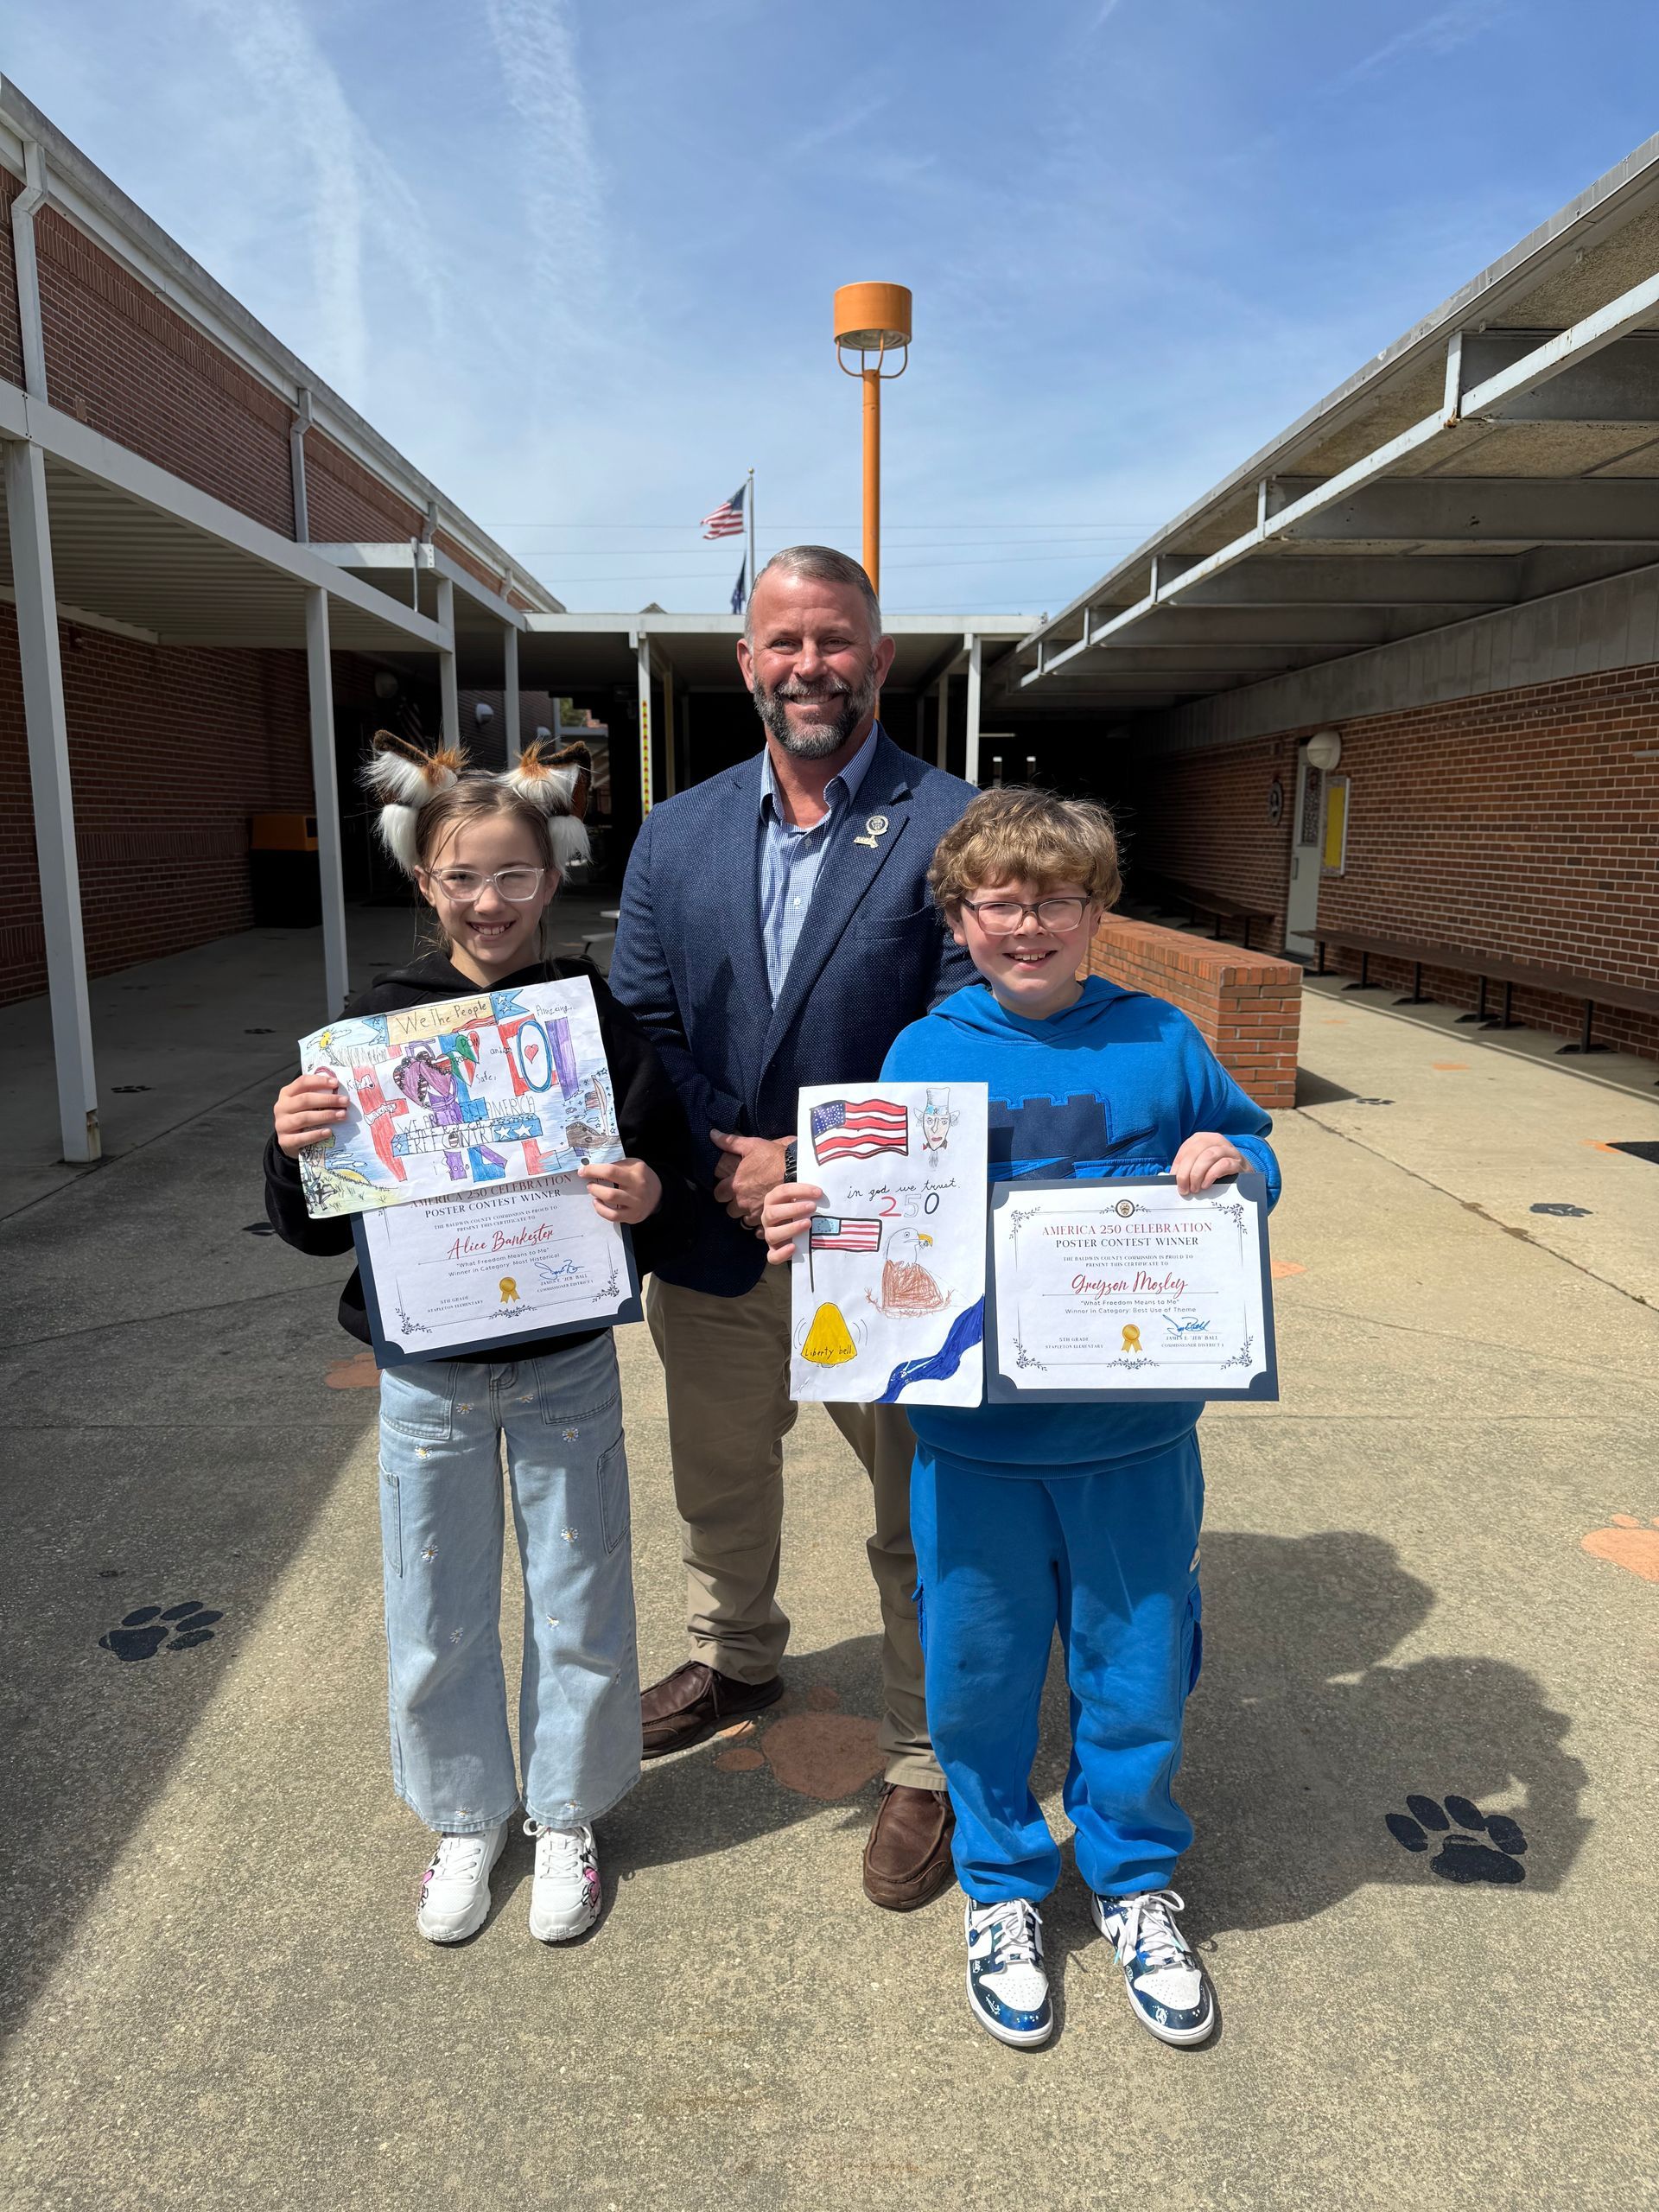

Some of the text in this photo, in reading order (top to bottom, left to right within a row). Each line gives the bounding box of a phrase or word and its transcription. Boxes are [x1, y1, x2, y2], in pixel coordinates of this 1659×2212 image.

[396, 1001, 487, 1035] We The People
[410, 1174, 572, 1209] AMERICA 250 CELEBRATION
[847, 1186, 863, 1198] in
[868, 1185, 890, 1201] god
[425, 1189, 561, 1218] POSTER CONTEST WINNER
[879, 1192, 940, 1217] 250
[493, 1211, 524, 1220] COMMISSION
[493, 1217, 527, 1225] CERTIFICATE
[1042, 1223, 1212, 1236] AMERICA 250 CELEBRATION
[447, 1223, 553, 1260] Alice Bankester
[1056, 1236, 1198, 1248] POSTER CONTEST WINNER
[477, 1256, 506, 1265] Freedom
[530, 1253, 560, 1262] Historical
[1071, 1270, 1188, 1300] Greyson Mosley
[805, 1344, 851, 1359] Liberty bell
